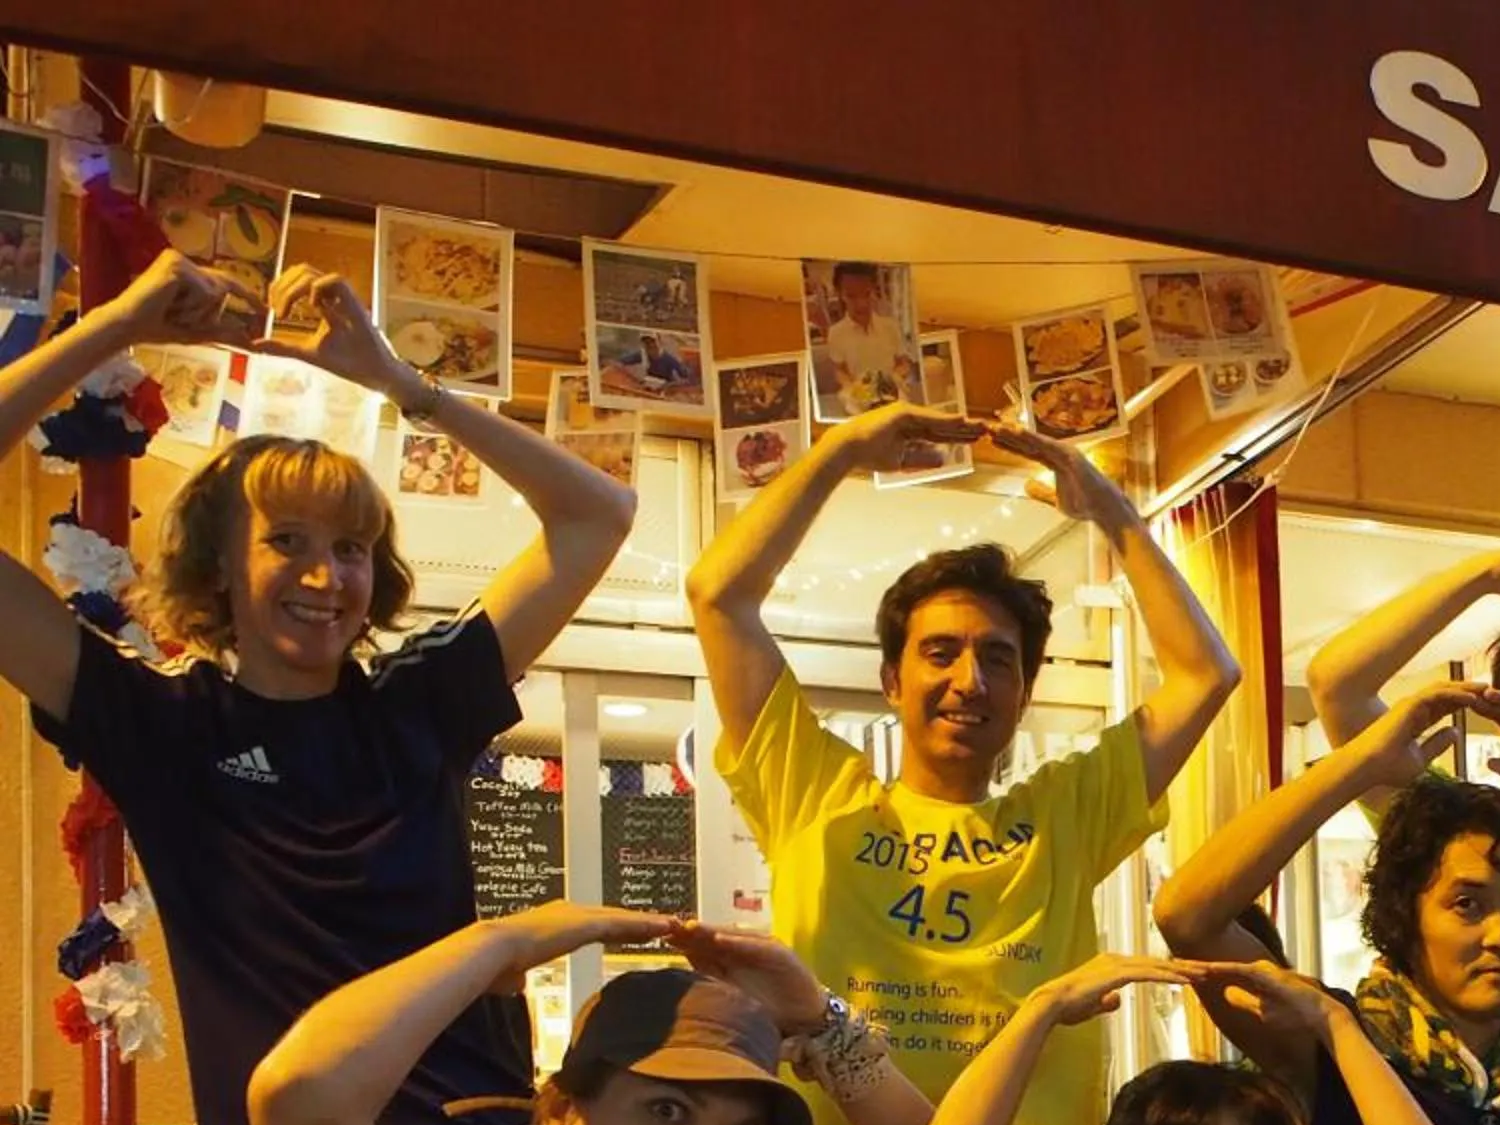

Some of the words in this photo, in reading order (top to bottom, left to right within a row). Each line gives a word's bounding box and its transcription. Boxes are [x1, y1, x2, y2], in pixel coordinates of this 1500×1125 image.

[888, 884, 971, 944] 4.5
[847, 976, 911, 999] Running
[915, 982, 927, 997] is
[863, 1006, 906, 1026] lping
[911, 1008, 975, 1026] children
[980, 1010, 991, 1026] is
[905, 1035, 927, 1049] do
[931, 1036, 943, 1050] it
